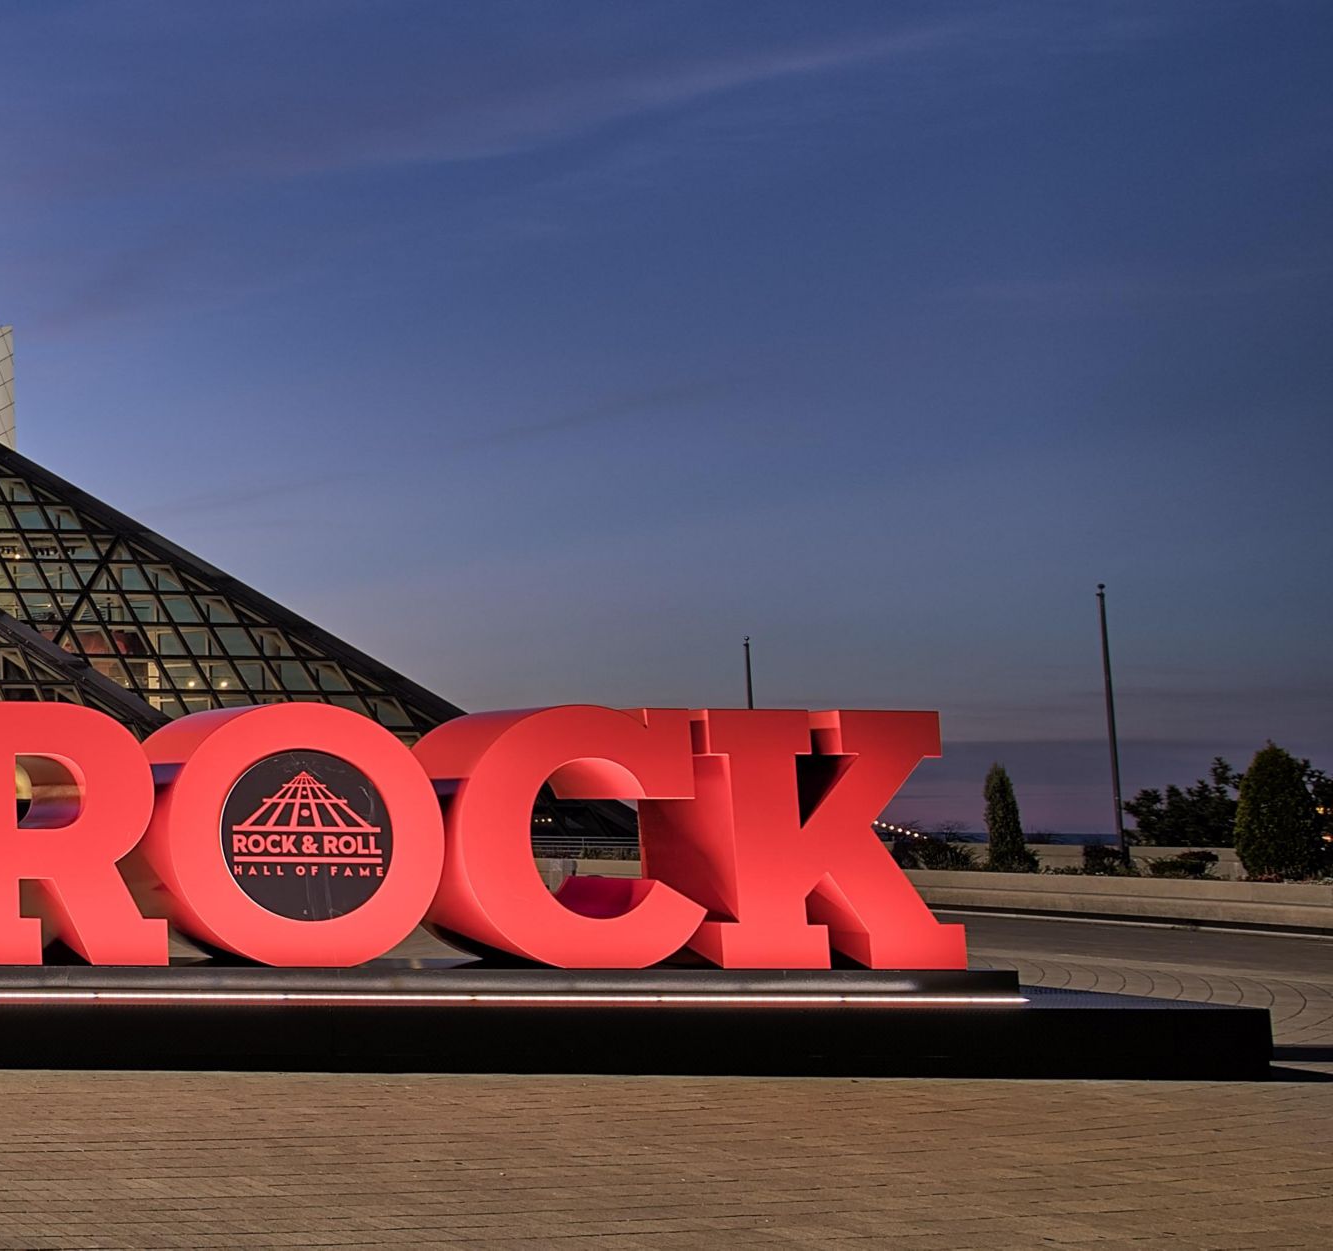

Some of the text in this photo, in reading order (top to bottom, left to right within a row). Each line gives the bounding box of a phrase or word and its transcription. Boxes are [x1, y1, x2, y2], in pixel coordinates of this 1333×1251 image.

[233, 834, 382, 855] ROCK & ROLL
[233, 865, 384, 877] HALL OF FAME
